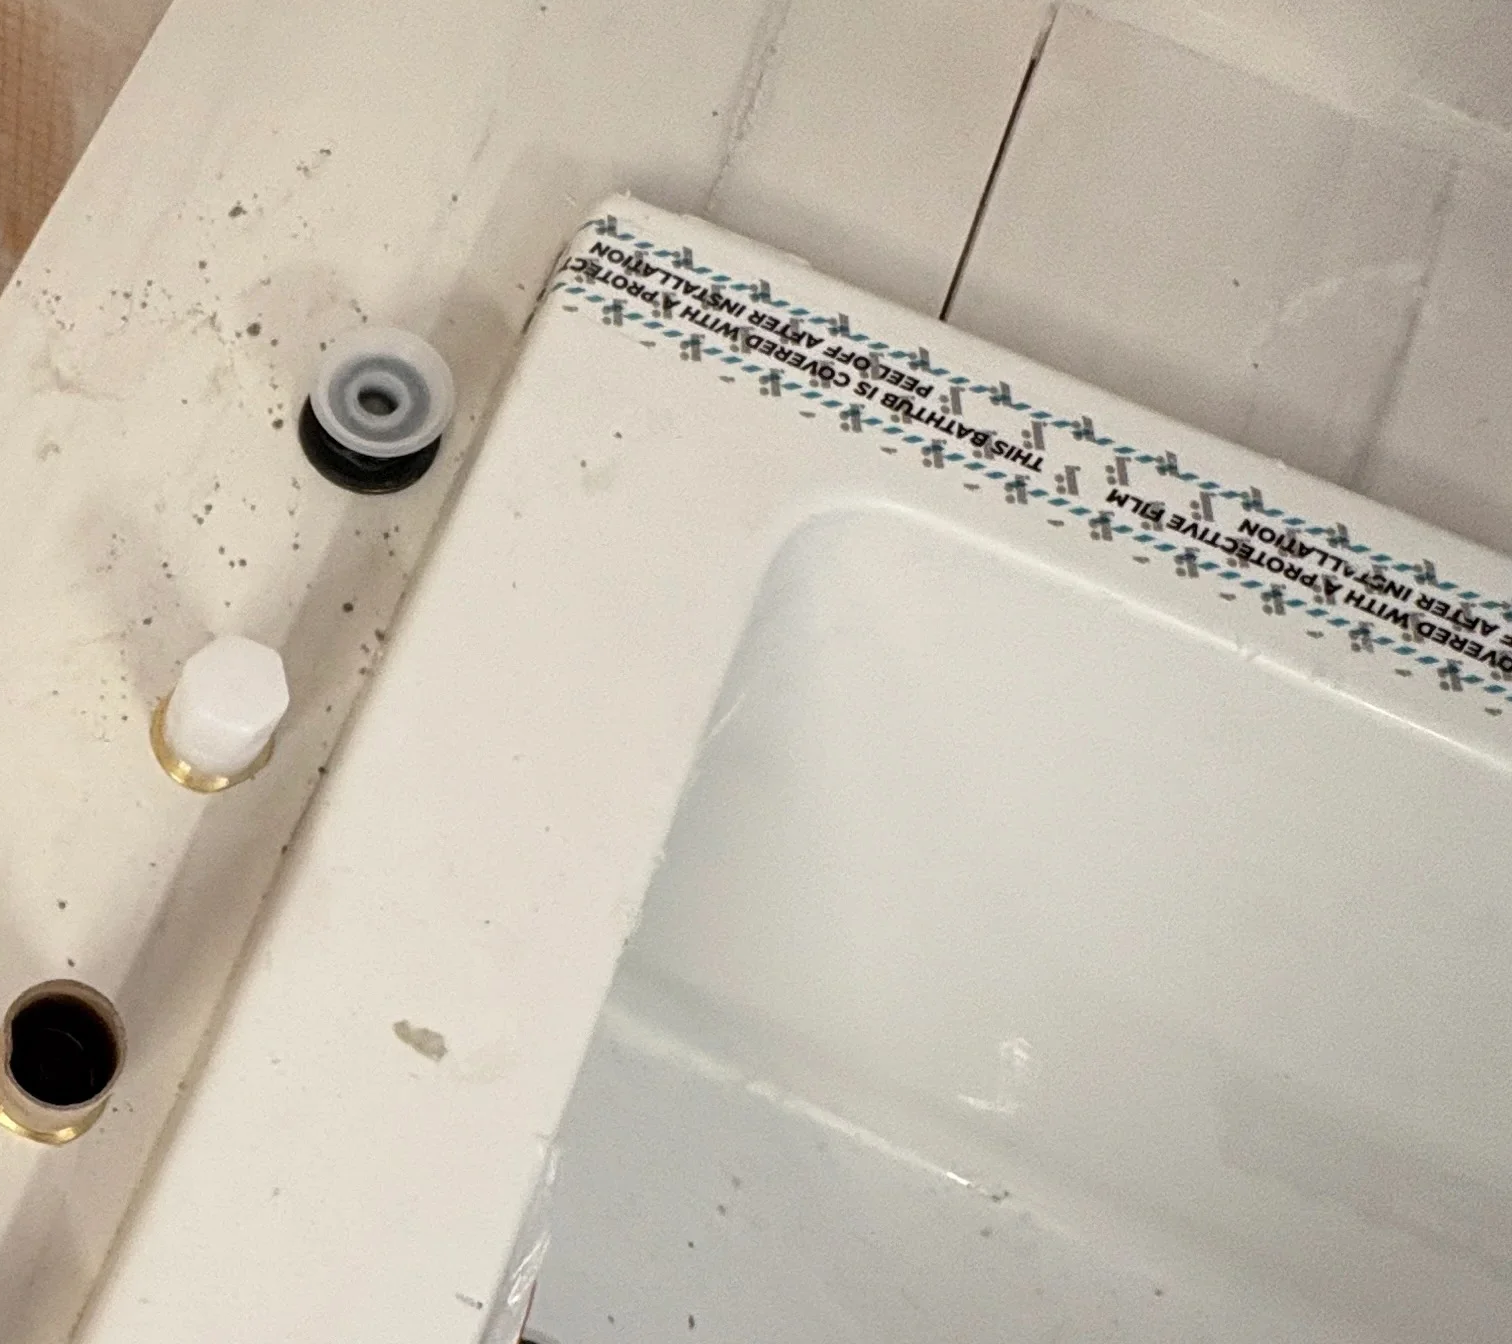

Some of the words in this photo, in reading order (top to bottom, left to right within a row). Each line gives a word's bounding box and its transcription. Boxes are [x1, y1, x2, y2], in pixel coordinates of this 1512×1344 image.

[589, 241, 747, 318] INSTALLATION
[660, 293, 681, 313] A
[679, 305, 743, 342] WITH
[747, 310, 824, 349] AFTER
[745, 334, 852, 387] COVERED
[823, 344, 873, 374] OFF
[853, 380, 879, 401] IS
[875, 363, 934, 399] PEEL
[880, 392, 990, 448] BATHTUB
[987, 440, 1045, 473] THIS
[1105, 488, 1166, 525] FILM
[1166, 513, 1319, 590] PROTECTIVE
[1238, 518, 1418, 605] INSTALLATION
[1321, 575, 1343, 599] A
[1344, 589, 1412, 630] WITH
[1415, 593, 1500, 638] AFTER
